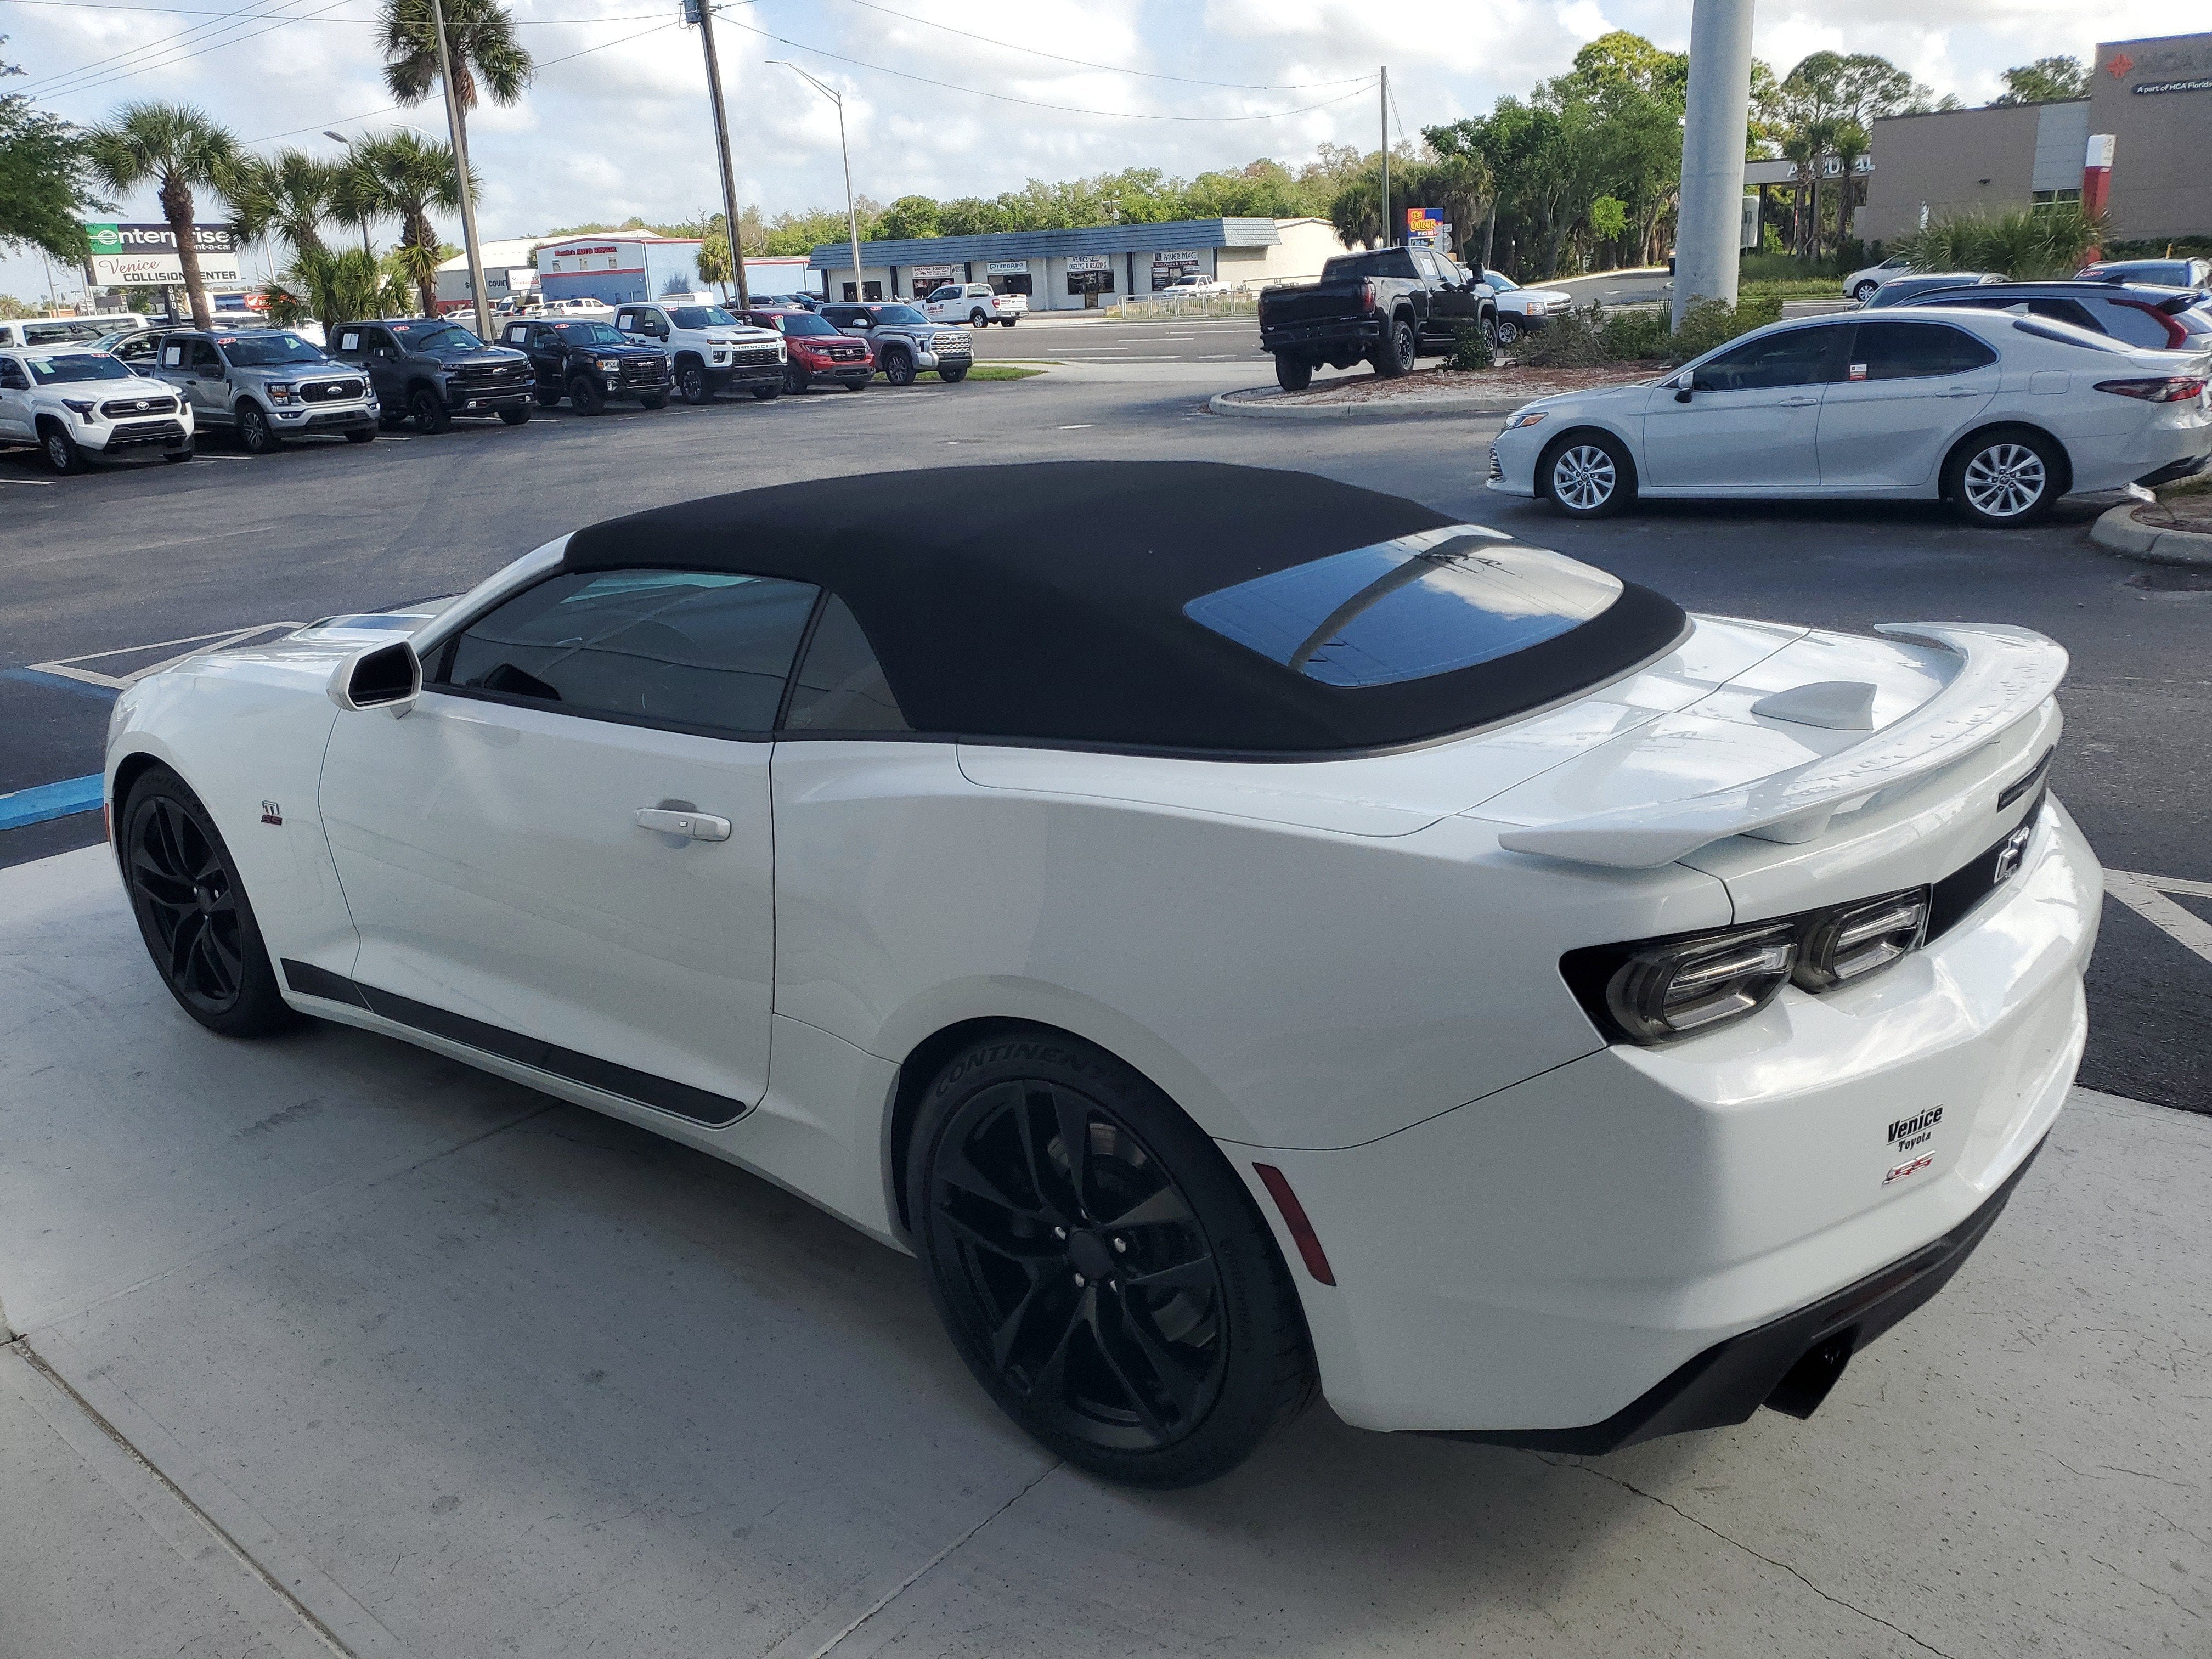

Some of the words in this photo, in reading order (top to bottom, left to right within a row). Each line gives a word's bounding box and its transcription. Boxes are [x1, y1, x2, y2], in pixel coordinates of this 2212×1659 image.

[89, 226, 230, 248] enterise
[1182, 251, 1197, 260] MAC
[98, 258, 160, 275] Venice
[123, 271, 185, 283] COLLISION
[200, 270, 237, 280] ENTER
[1888, 1107, 1943, 1143] Venice
[1898, 1131, 1932, 1153] Toyota
